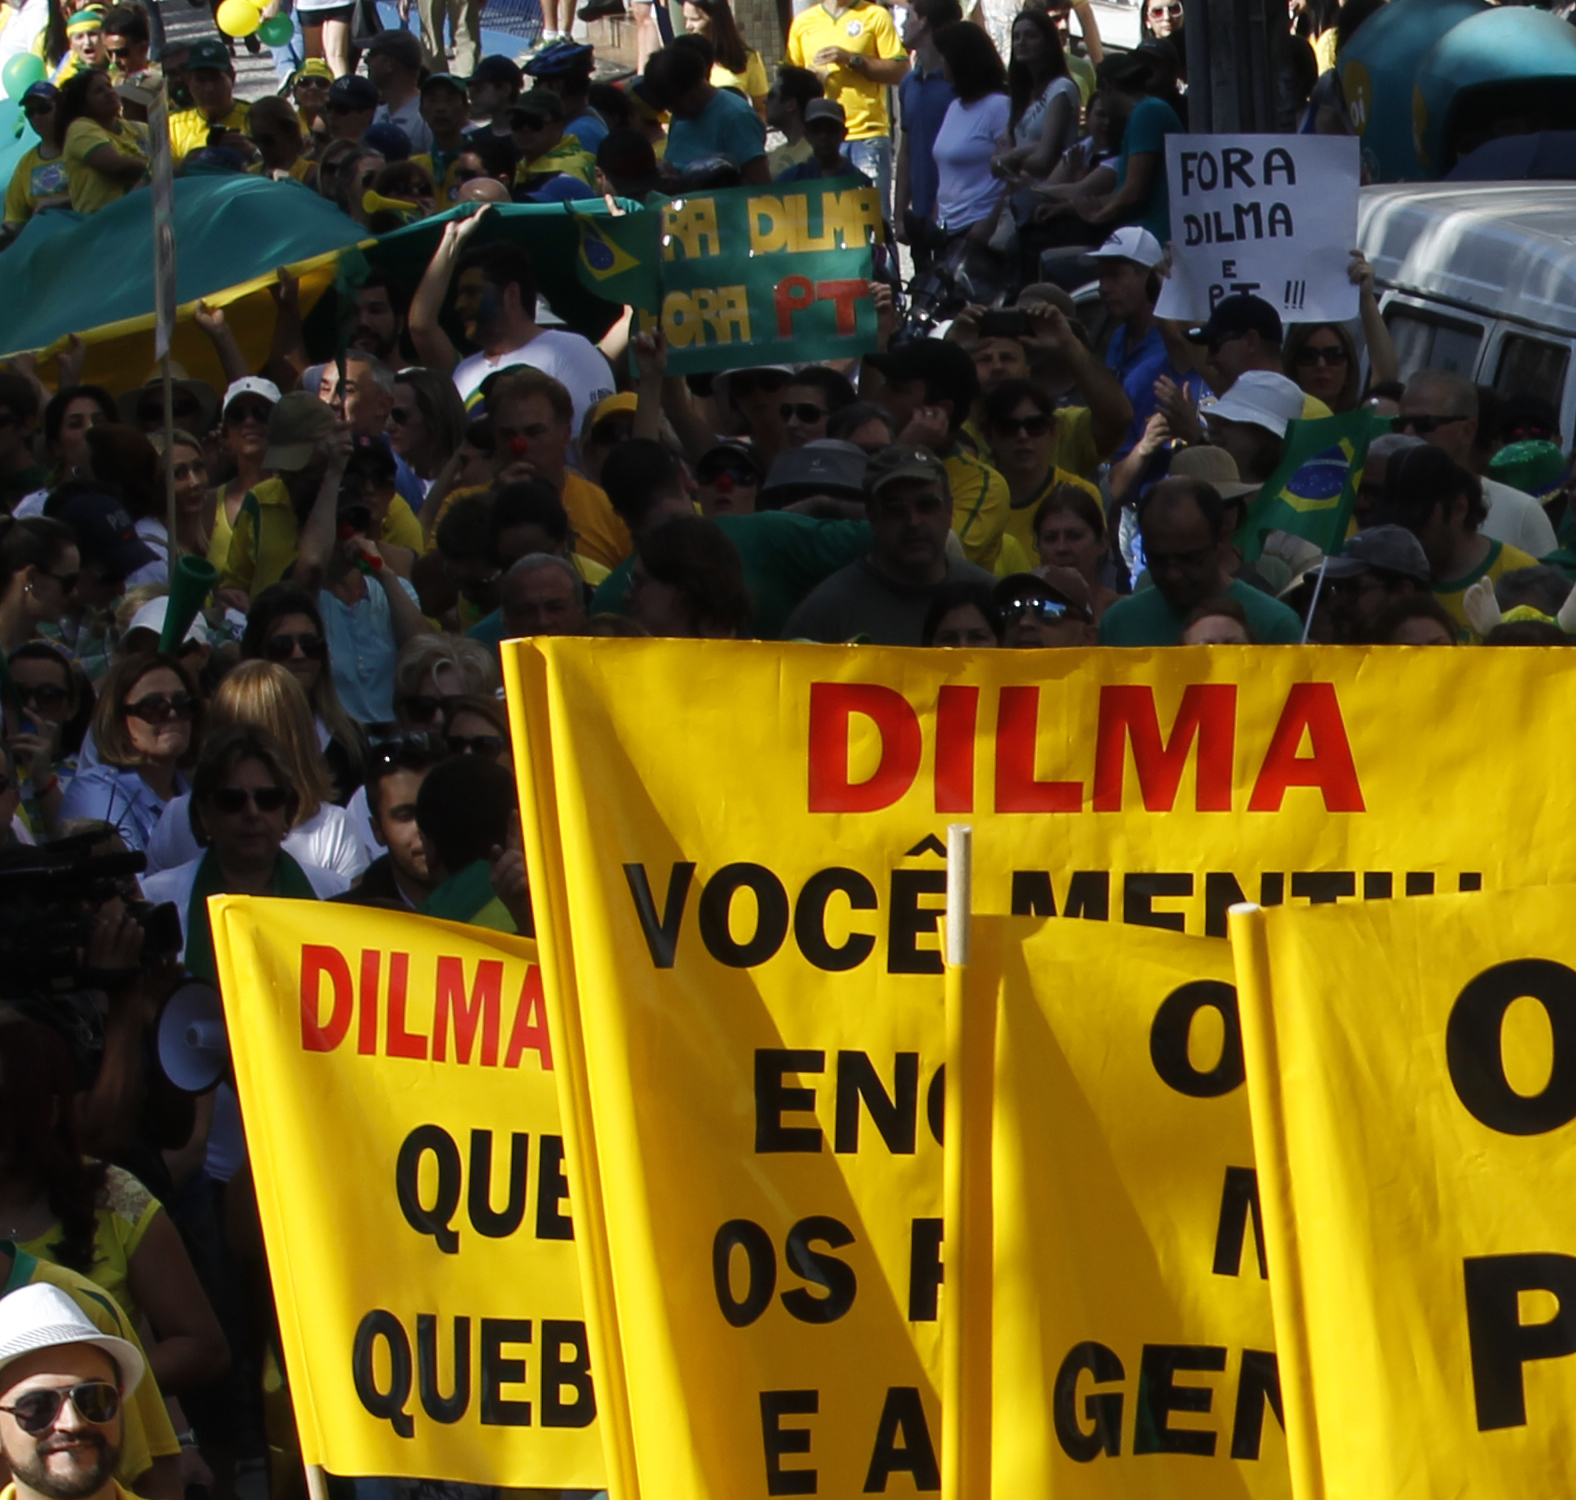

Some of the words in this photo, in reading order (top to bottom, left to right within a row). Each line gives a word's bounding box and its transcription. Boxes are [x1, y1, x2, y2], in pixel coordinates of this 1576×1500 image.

[748, 186, 884, 256] DILMA
[1180, 147, 1296, 196] FORA
[1183, 202, 1294, 246] DILMA
[773, 274, 869, 340] PT
[1222, 260, 1237, 279] E
[807, 681, 1366, 815] DILMA
[623, 834, 948, 975] VOCÊ
[301, 944, 553, 1072] DILMA
[753, 1048, 946, 1156] EN
[711, 1216, 857, 1328] OS
[760, 1388, 819, 1496] E
